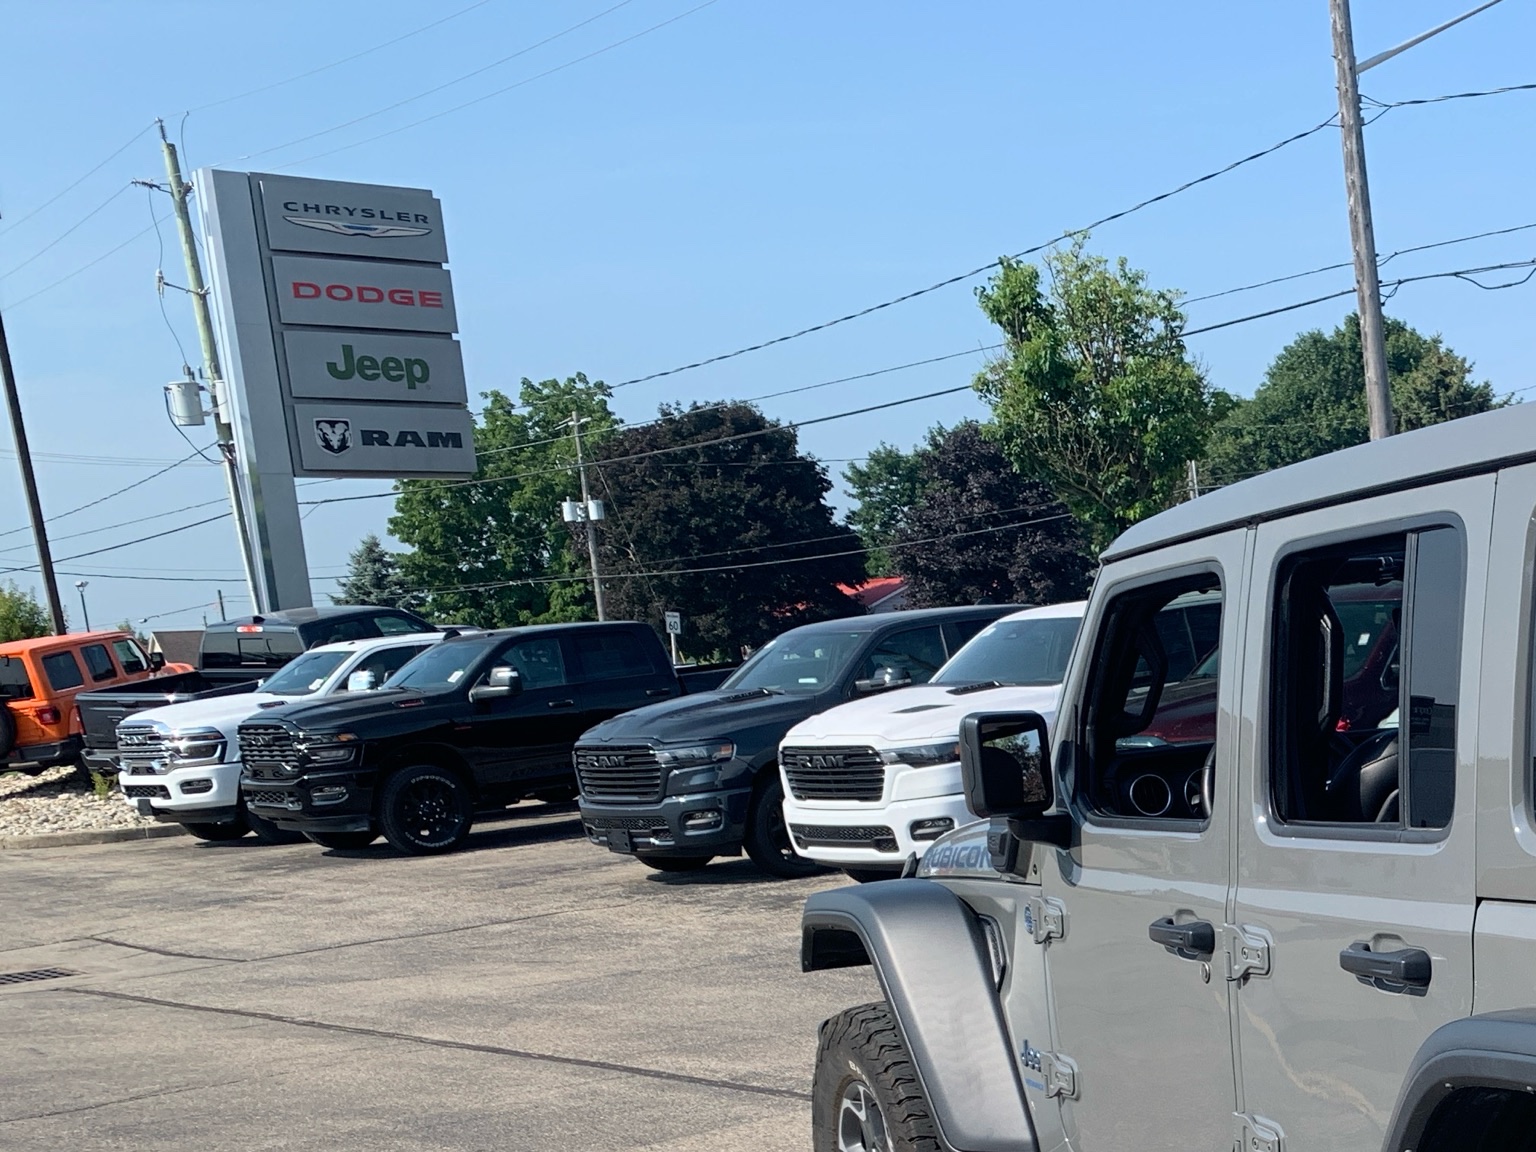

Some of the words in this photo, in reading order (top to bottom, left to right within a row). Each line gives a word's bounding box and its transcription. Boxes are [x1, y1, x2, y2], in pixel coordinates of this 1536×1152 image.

[283, 201, 430, 224] CHRYSLER
[292, 282, 444, 308] DODGE
[326, 344, 430, 389] Jeep
[360, 429, 463, 448] RAM
[668, 620, 679, 631] 60
[585, 755, 626, 768] RAM
[796, 754, 846, 769] RAM
